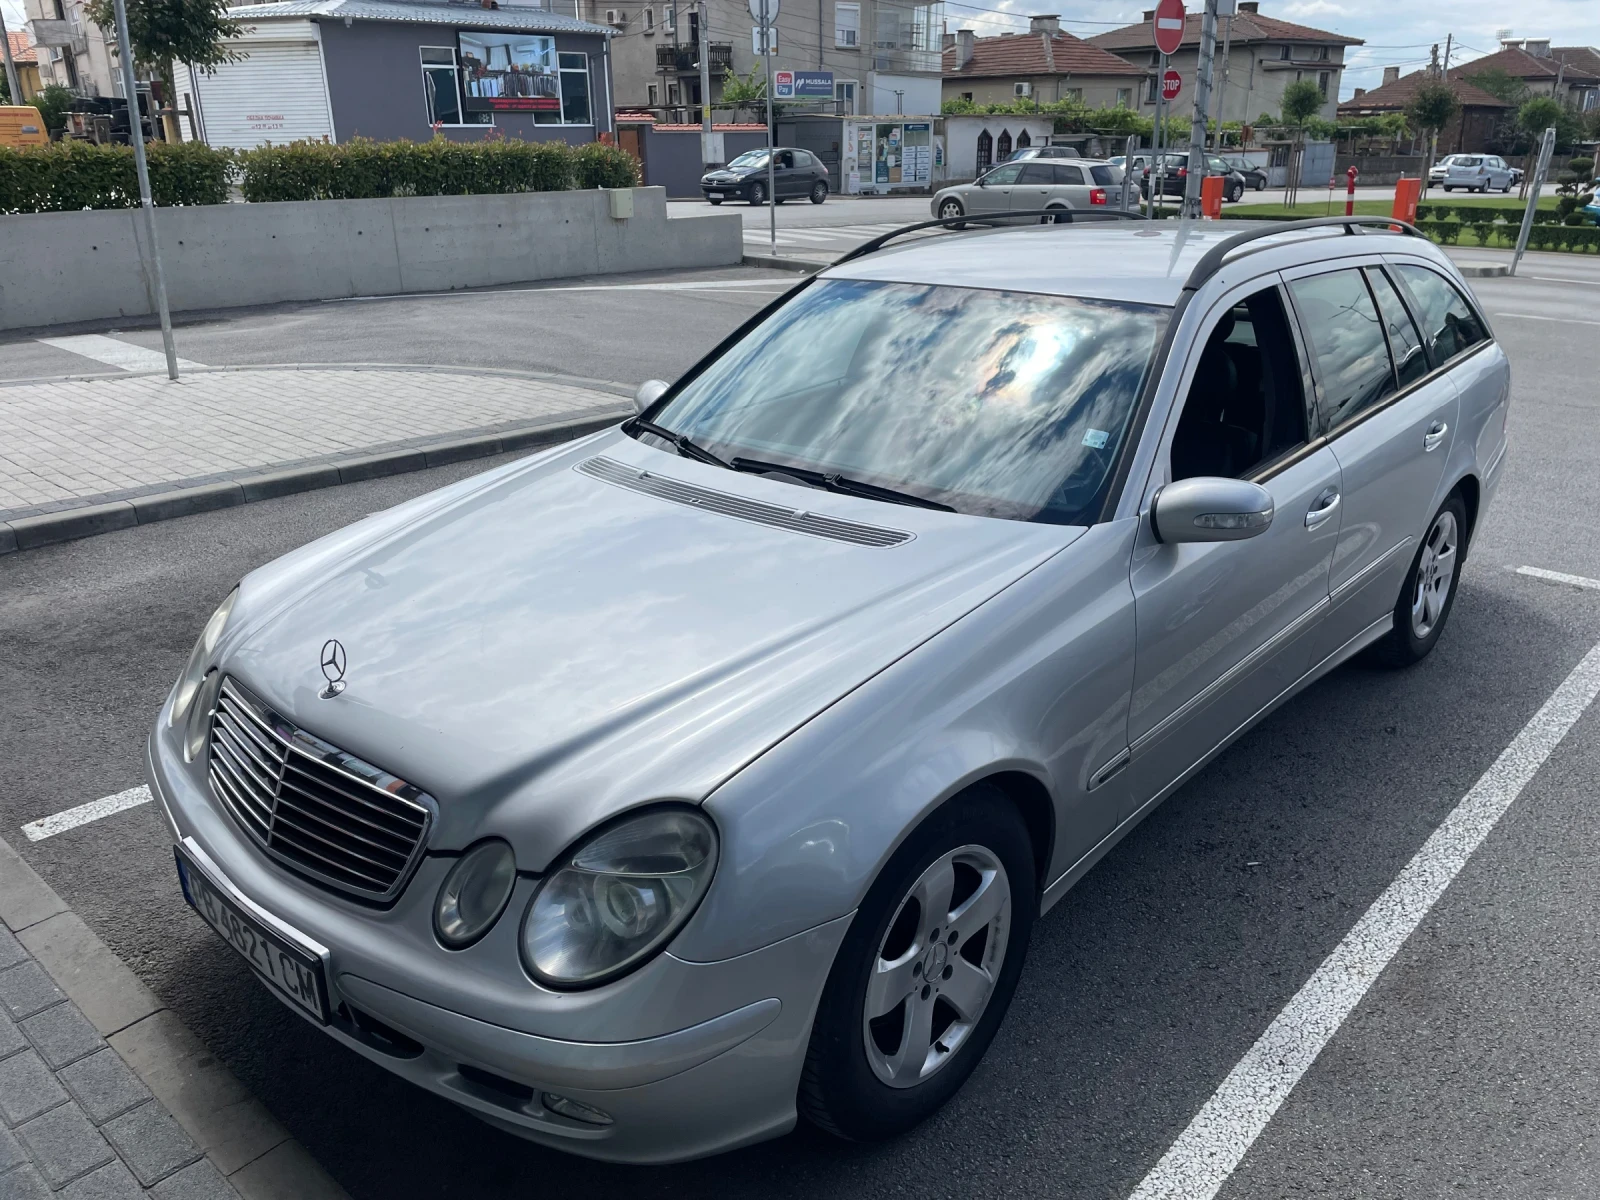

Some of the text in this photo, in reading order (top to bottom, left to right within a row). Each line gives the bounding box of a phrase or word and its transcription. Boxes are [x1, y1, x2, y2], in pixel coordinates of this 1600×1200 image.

[778, 75, 791, 84] Easy
[778, 85, 789, 94] Pay
[1162, 80, 1180, 90] STOP
[220, 903, 276, 978] 4821
[278, 951, 319, 1012] CM
